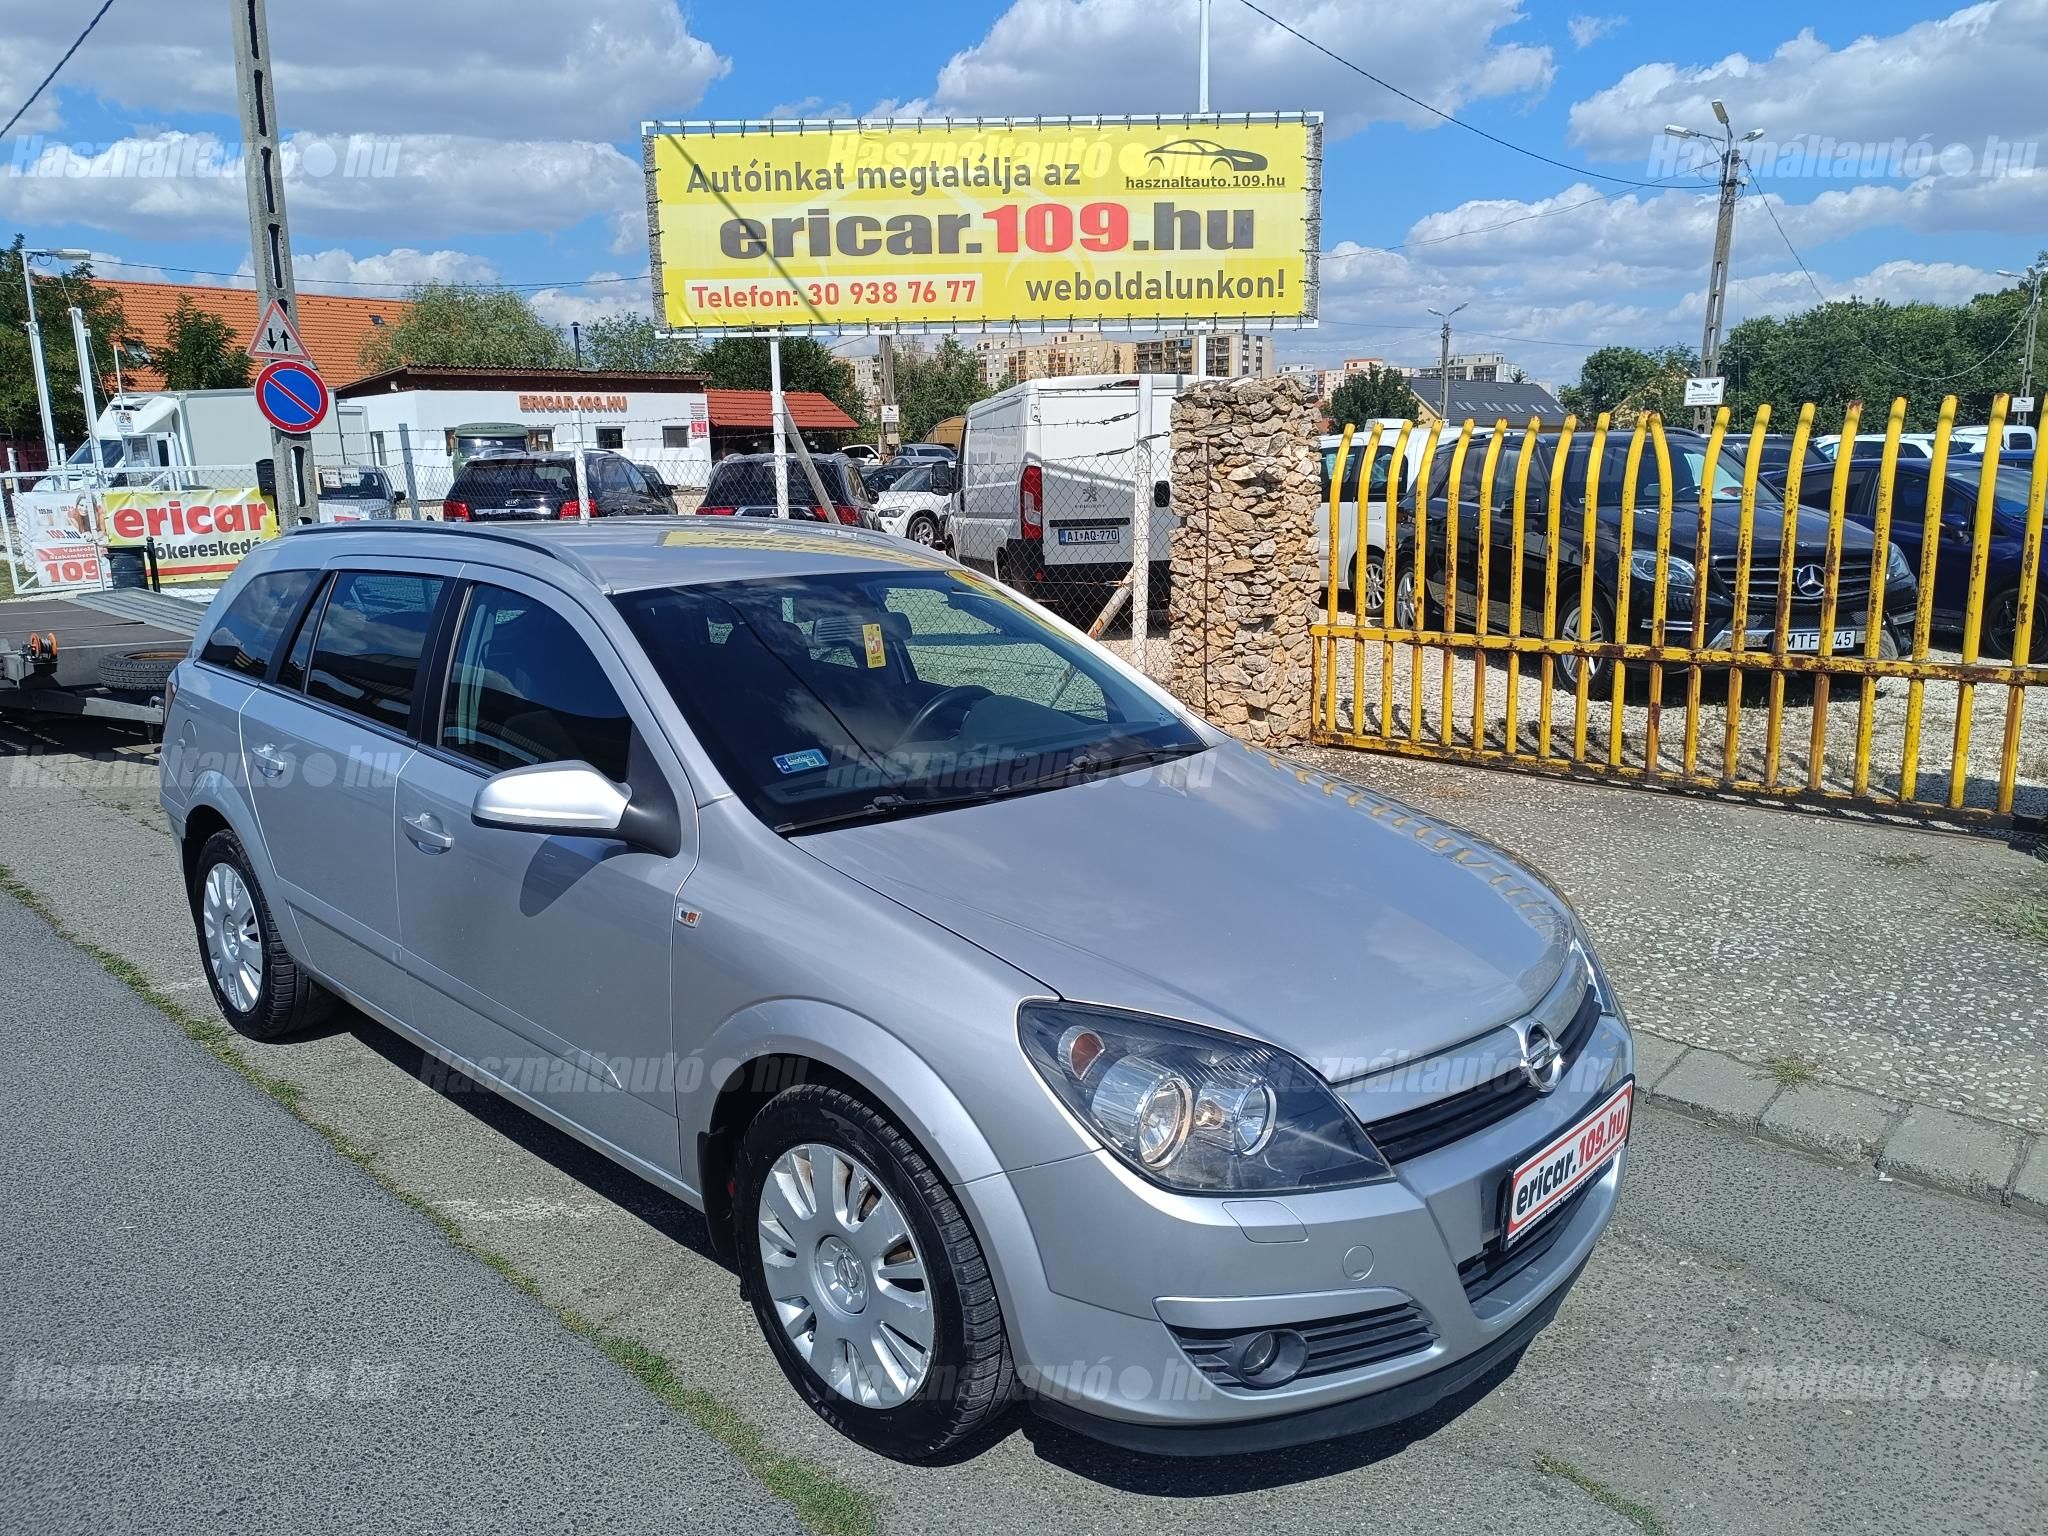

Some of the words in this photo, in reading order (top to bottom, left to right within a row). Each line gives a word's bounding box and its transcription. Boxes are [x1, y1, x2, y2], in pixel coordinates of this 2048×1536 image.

[686, 158, 845, 193] Autóinkat
[858, 153, 1031, 195] megtalálja
[1043, 163, 1081, 186] az
[1125, 175, 1286, 188] hasznaltauto.109.hu
[720, 202, 1254, 259] ericar.109.hu
[692, 285, 799, 308] Telefon:
[808, 282, 839, 306] 30
[850, 281, 898, 304] 938
[907, 281, 936, 303] 76
[946, 280, 976, 302] 77
[1026, 269, 1285, 301] weboldalunkon!
[519, 395, 627, 412] ERICAR.109.HU
[113, 500, 268, 538] ericar
[1516, 1105, 1625, 1216] ericar.109.hu
